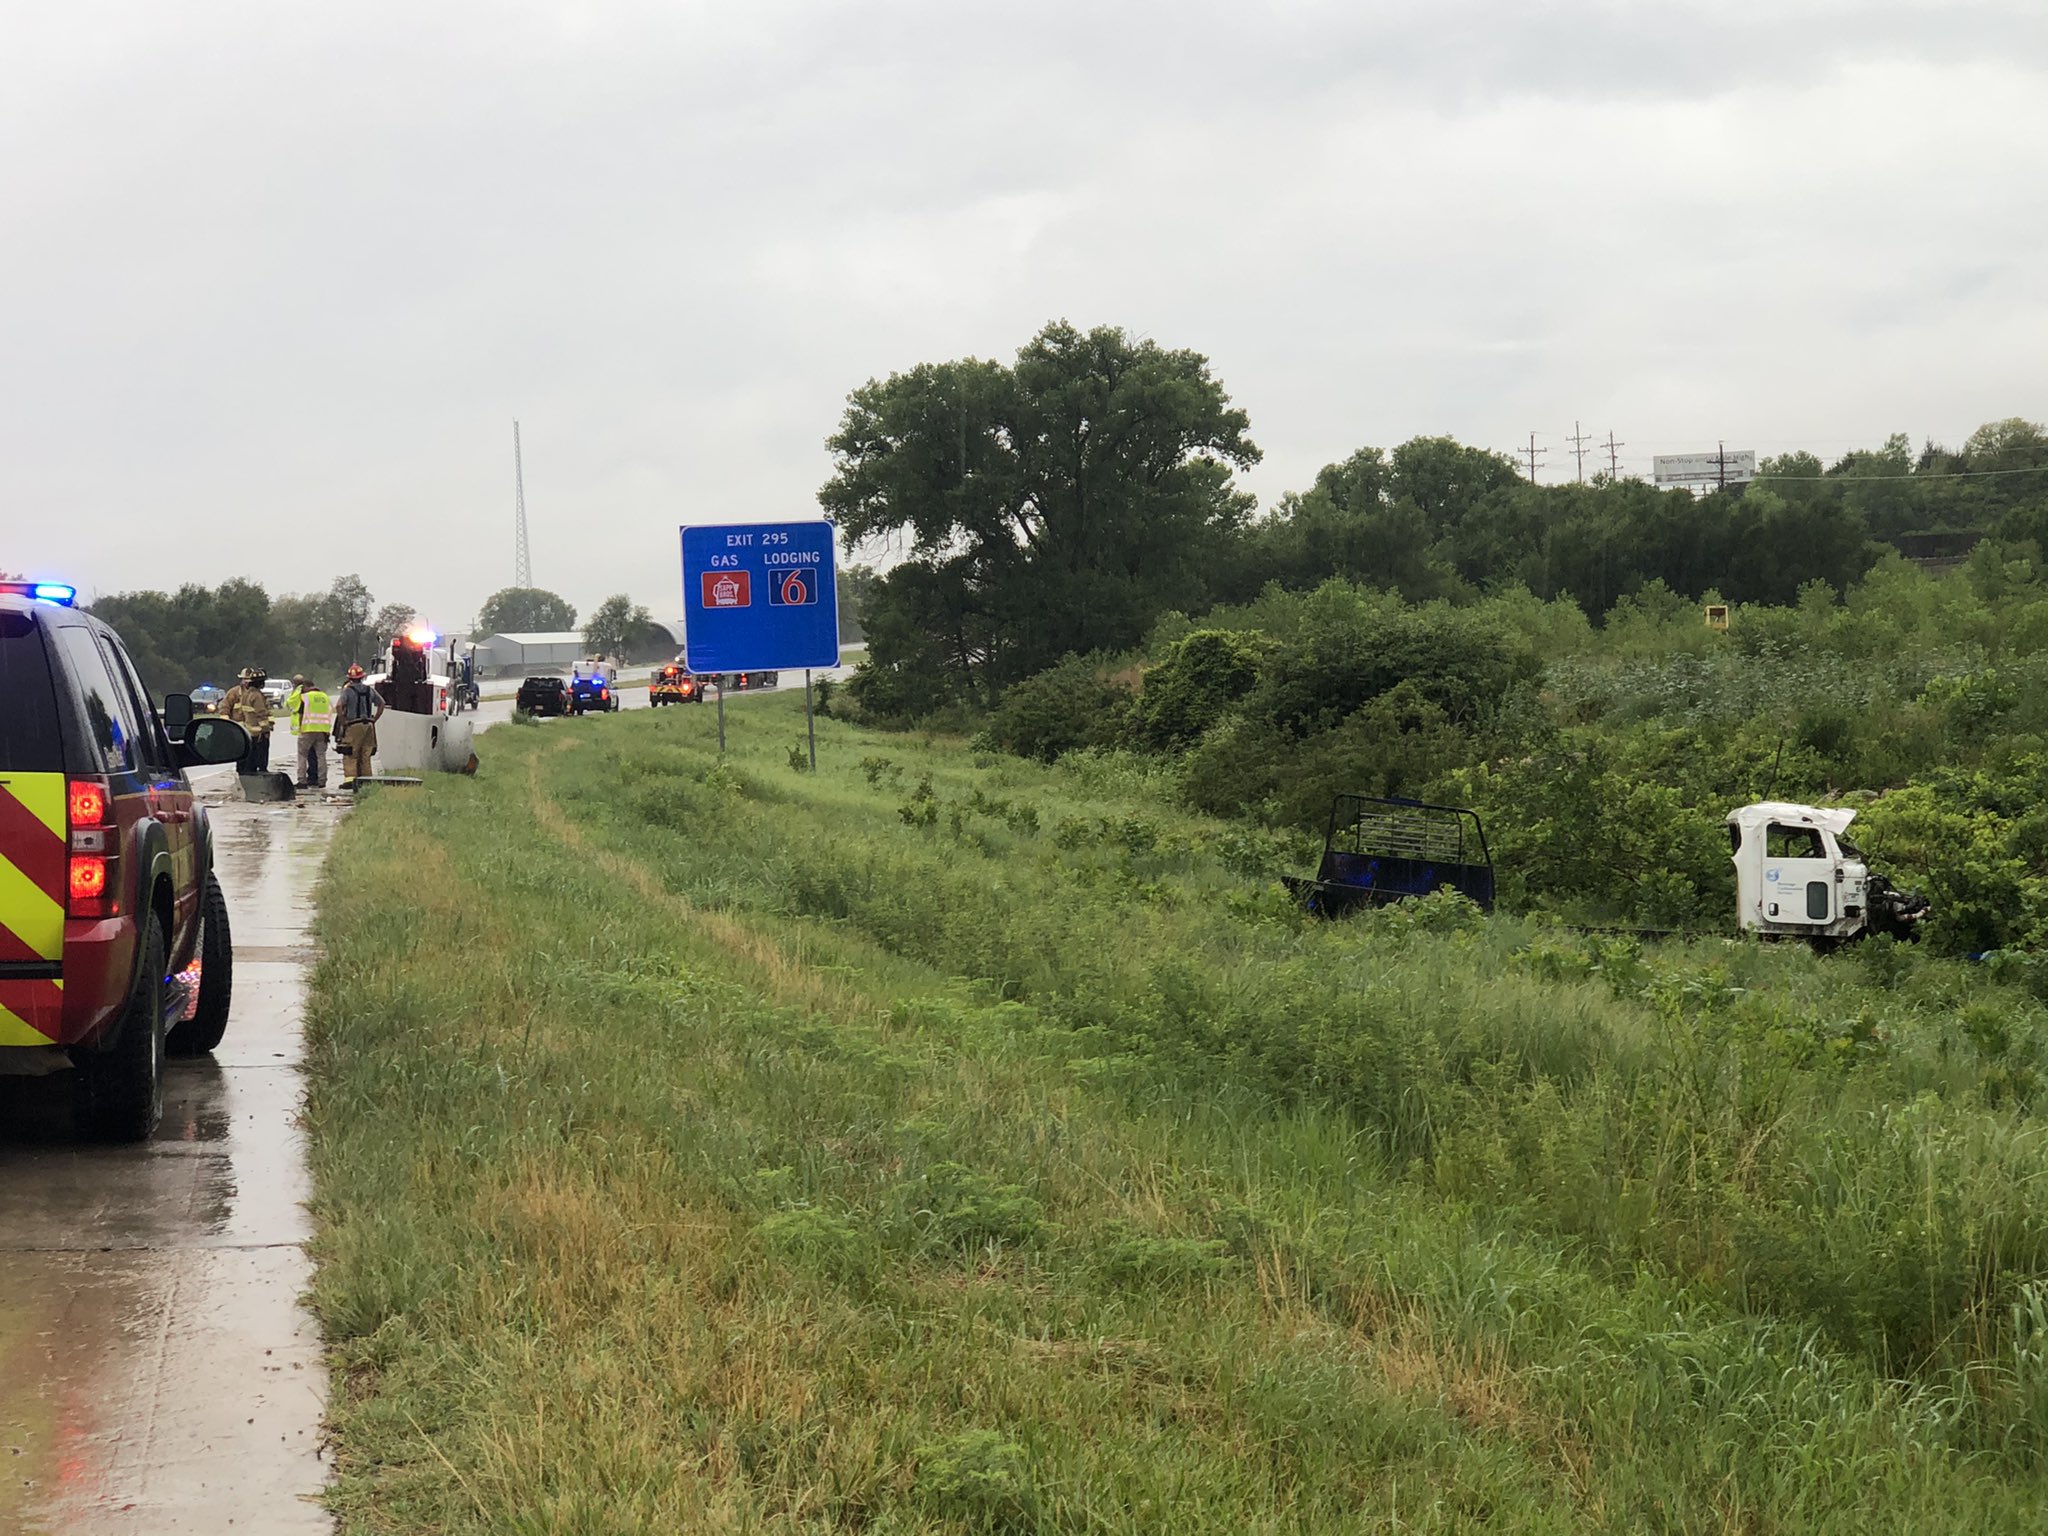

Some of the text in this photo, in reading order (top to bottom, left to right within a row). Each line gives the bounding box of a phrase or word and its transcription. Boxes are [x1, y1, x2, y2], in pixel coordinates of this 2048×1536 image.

[727, 533, 788, 546] EXIT 295
[711, 555, 739, 567] GAS
[764, 552, 820, 564] LODGING
[781, 569, 807, 606] 6
